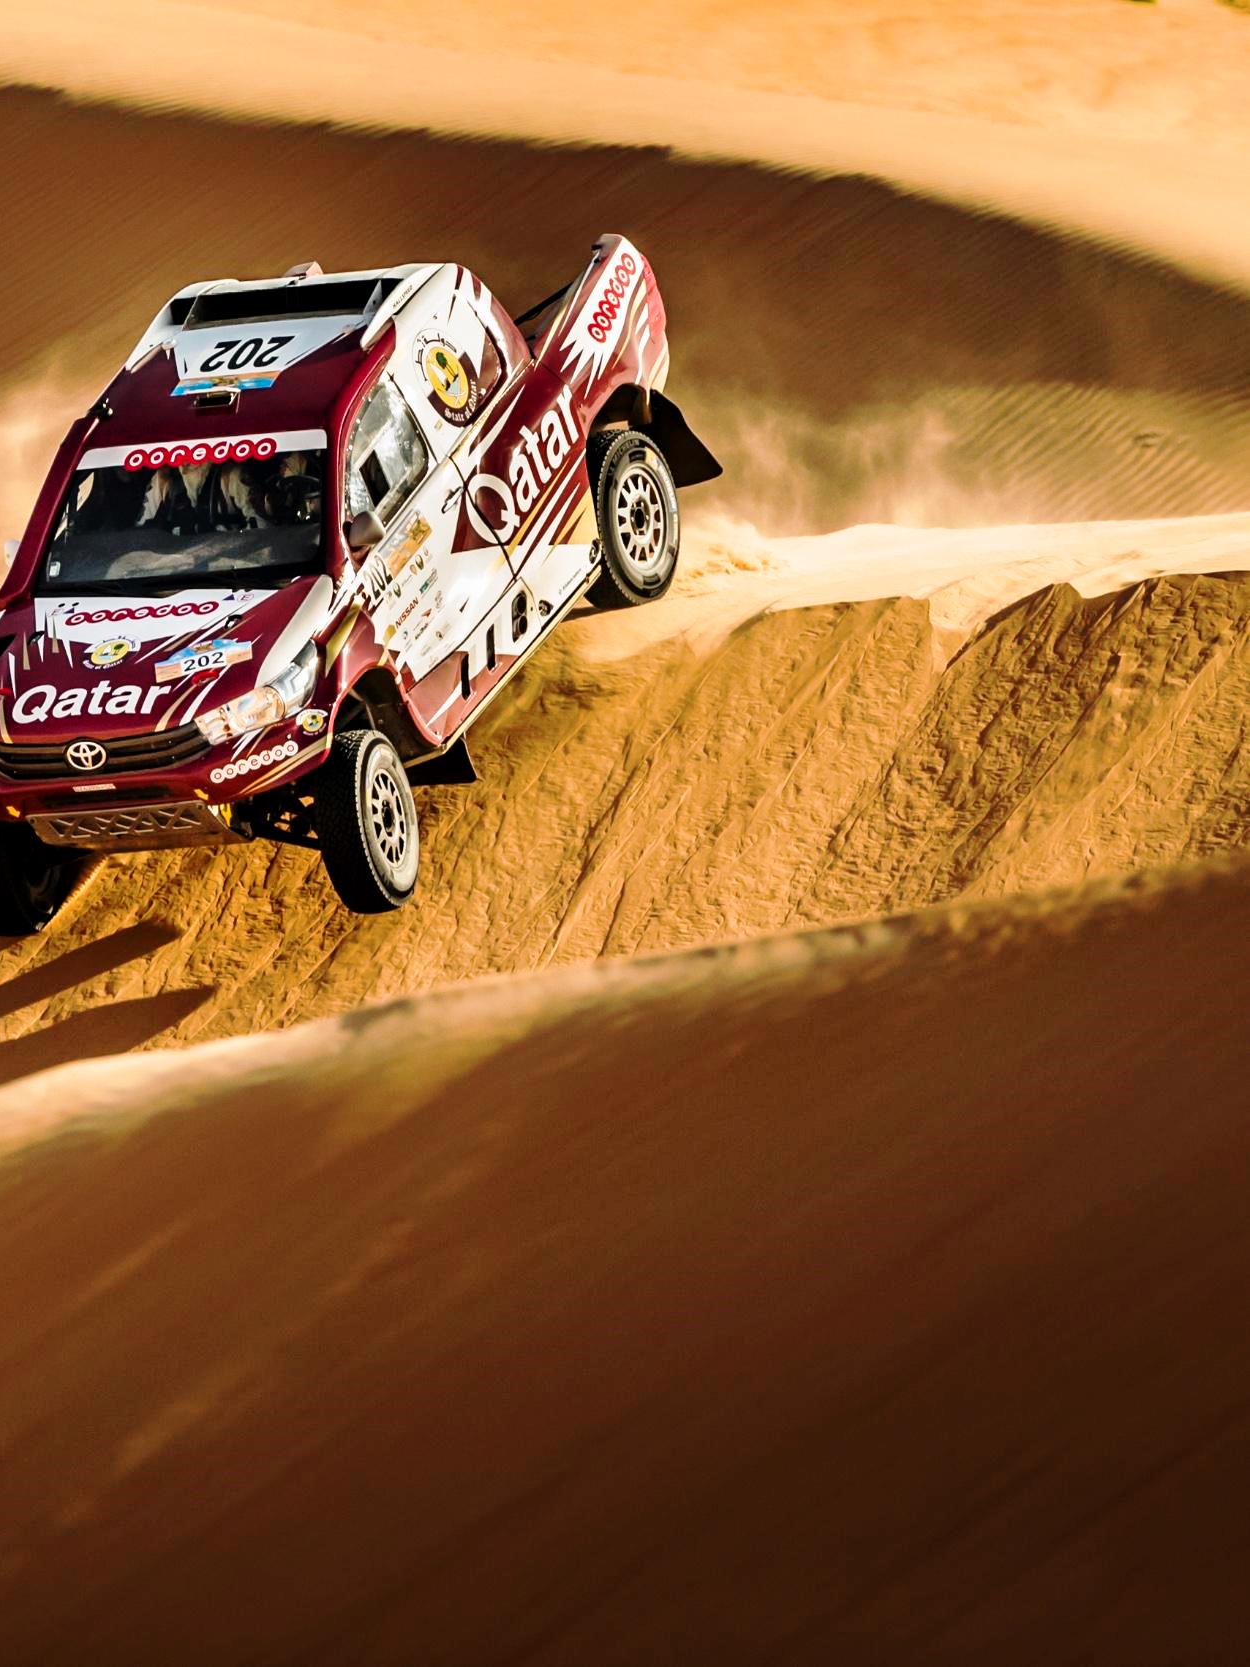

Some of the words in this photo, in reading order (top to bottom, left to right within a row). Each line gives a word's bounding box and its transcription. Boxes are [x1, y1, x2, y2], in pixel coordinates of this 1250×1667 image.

[589, 254, 635, 342] ooredoo
[200, 335, 295, 372] 202
[127, 440, 273, 468] ooredoo
[465, 384, 579, 544] Qatar
[363, 553, 393, 599] 202
[69, 602, 215, 624] ooredoo
[395, 597, 419, 628] NISSAN
[183, 652, 225, 672] 202
[12, 679, 173, 724] Qatar
[212, 742, 297, 782] ooredoo
